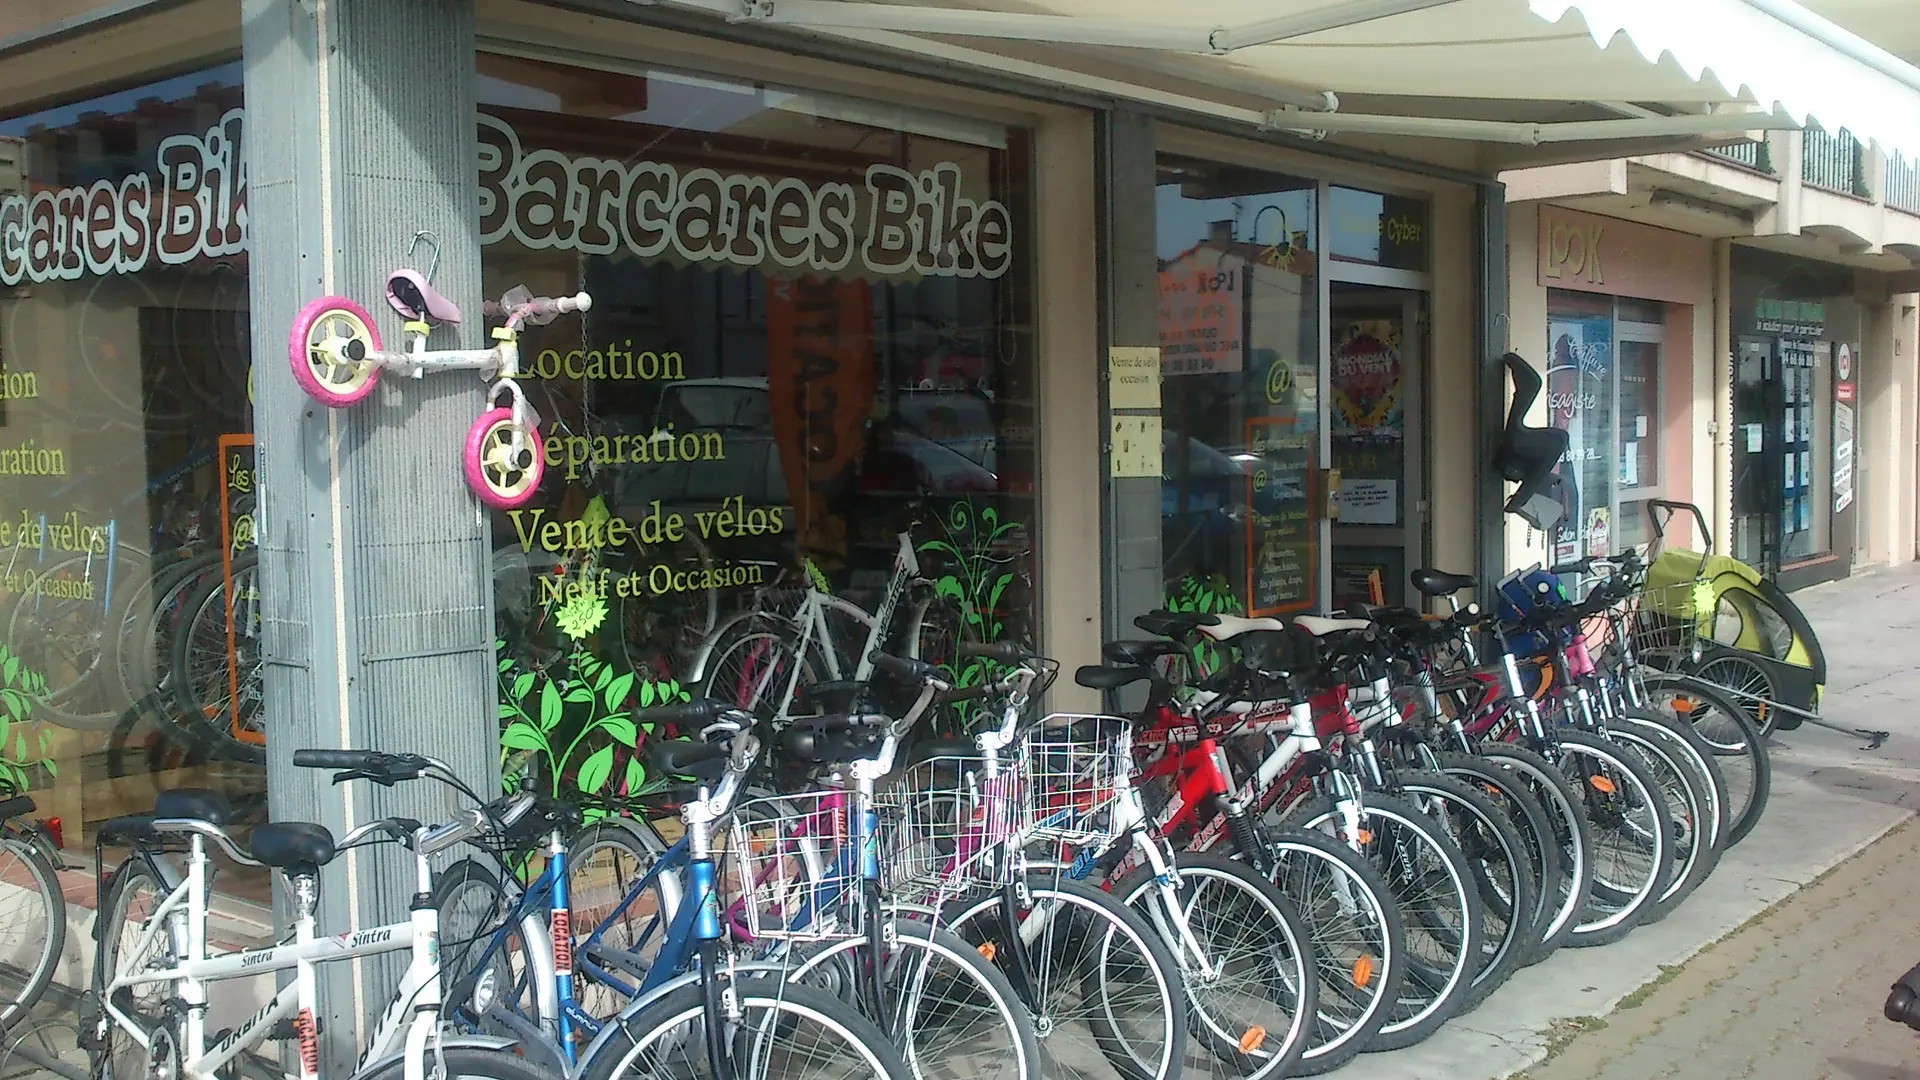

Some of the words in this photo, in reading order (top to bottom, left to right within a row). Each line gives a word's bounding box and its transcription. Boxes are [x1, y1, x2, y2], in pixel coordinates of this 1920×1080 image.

[477, 112, 856, 271] Barcares
[862, 162, 1013, 279] Bike
[544, 421, 726, 480] éparation
[18, 508, 42, 549] de
[47, 511, 106, 553] vélos
[507, 508, 628, 552] Vente
[640, 500, 684, 544] de
[694, 495, 784, 540] vélos
[537, 568, 610, 606] Neuf
[615, 574, 641, 598] et
[649, 560, 763, 595] Occasion
[240, 949, 273, 968] Sintra
[352, 929, 391, 949] Sintra
[553, 911, 571, 971] LOCATION
[299, 1009, 318, 1074] LOCATION
